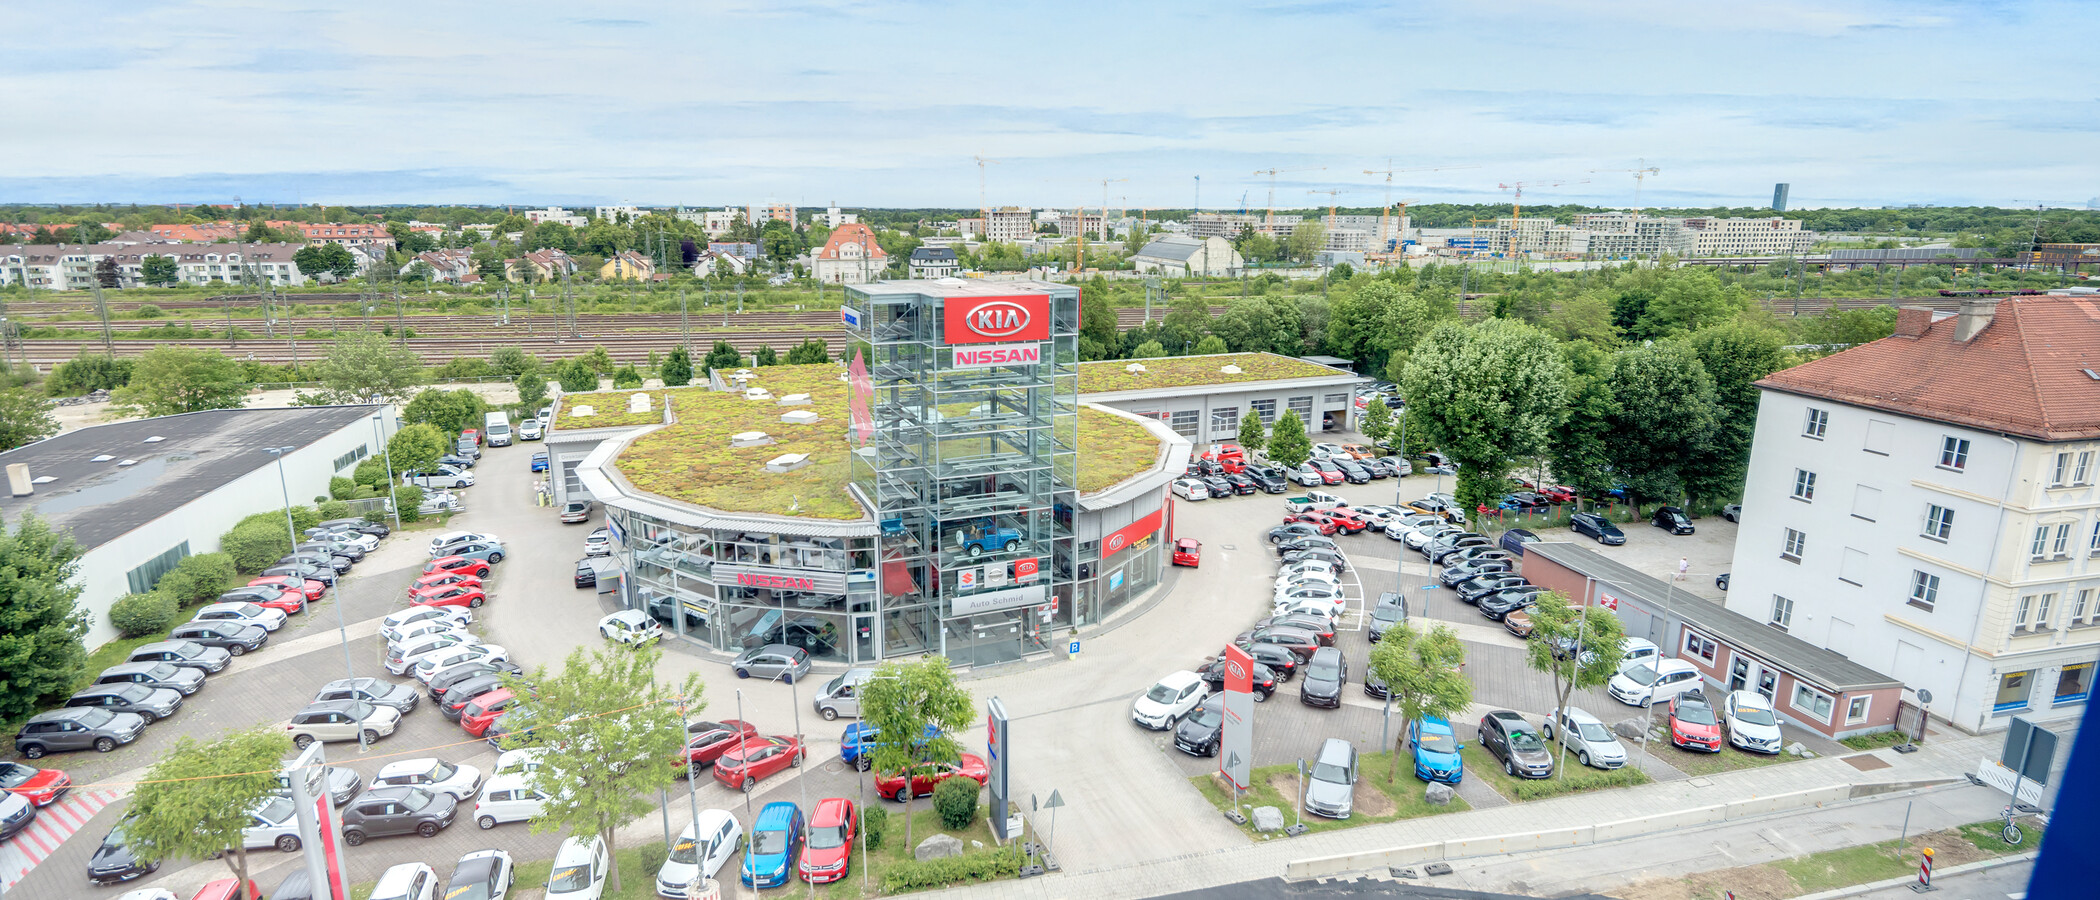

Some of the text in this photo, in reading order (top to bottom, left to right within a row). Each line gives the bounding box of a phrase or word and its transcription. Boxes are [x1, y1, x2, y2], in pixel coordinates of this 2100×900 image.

[978, 309, 1020, 329] KIA
[956, 348, 1038, 365] NISSAN
[1112, 537, 1122, 548] KIA
[737, 573, 814, 590] NISSAN
[970, 594, 1024, 609] Auto Schmid
[1229, 662, 1242, 678] KIA
